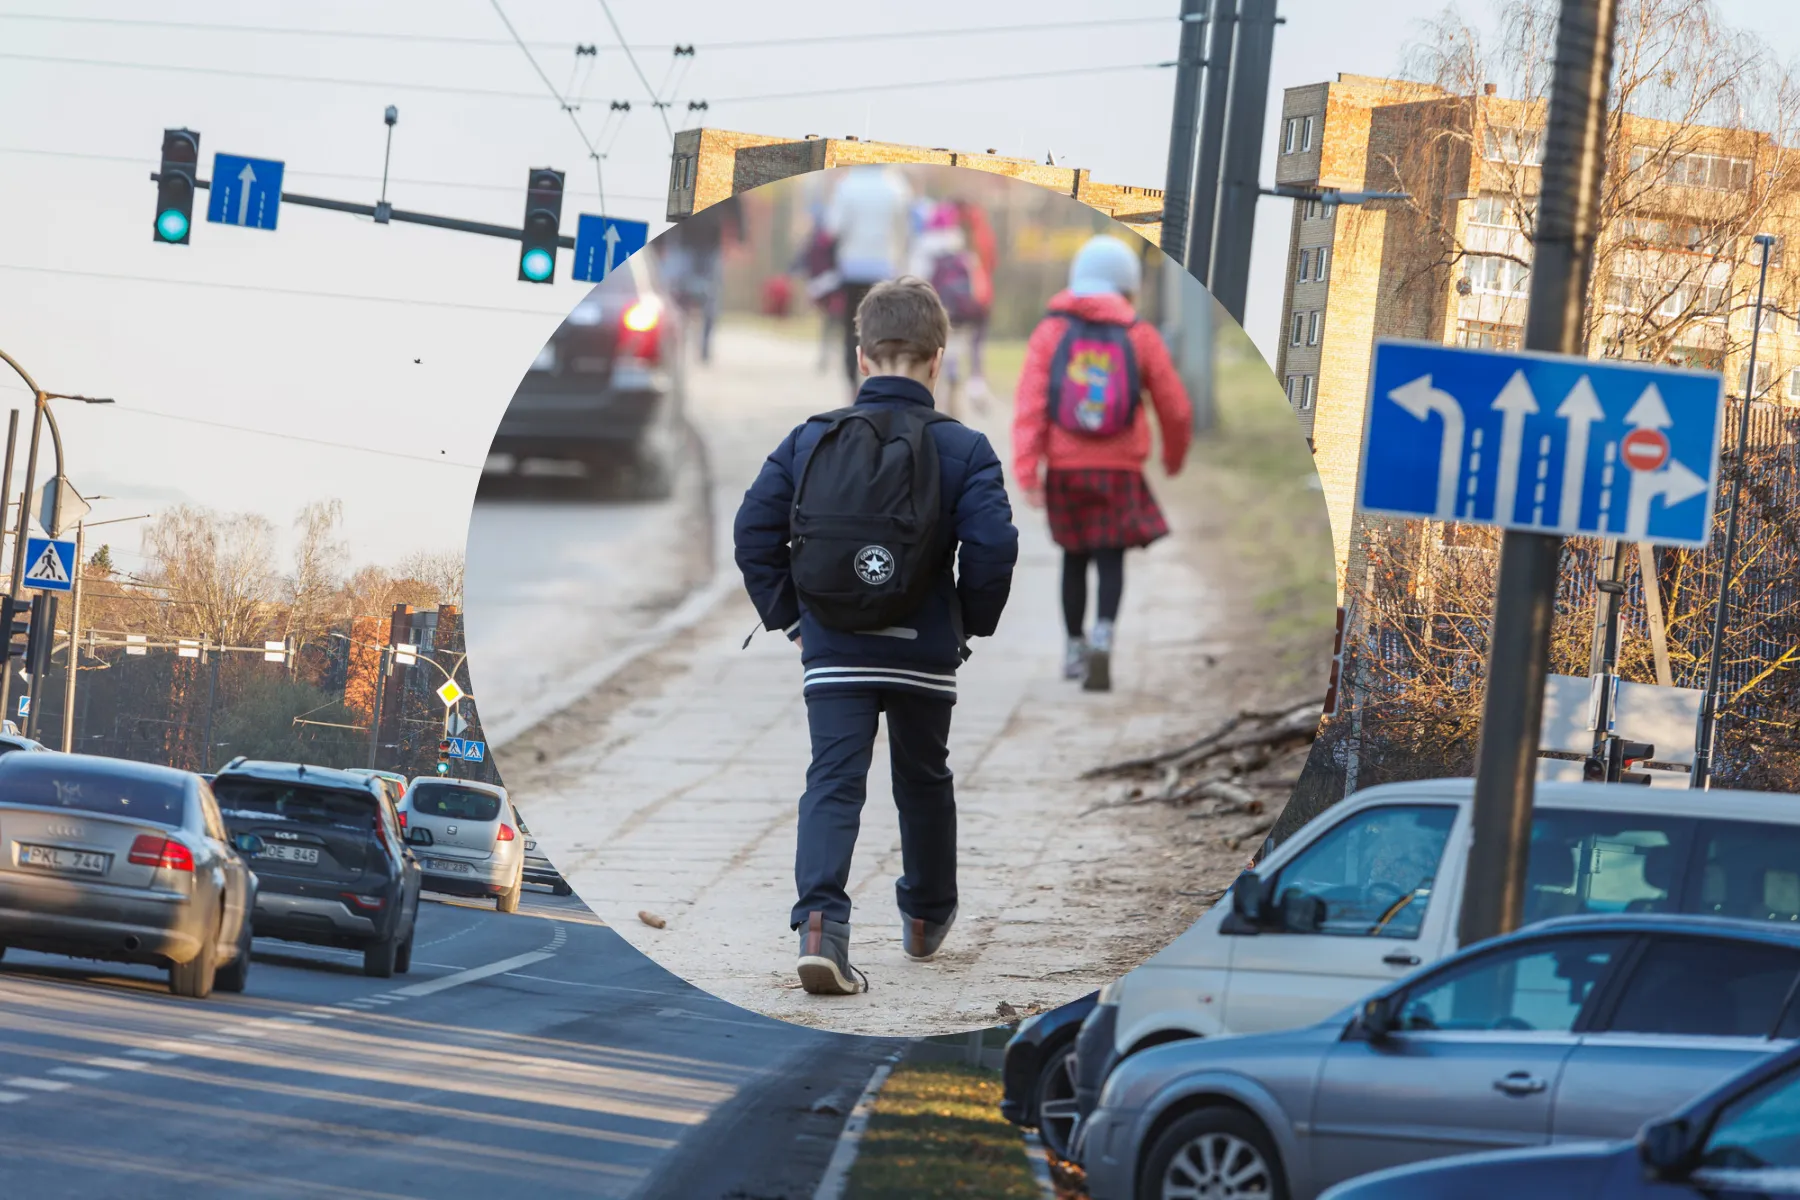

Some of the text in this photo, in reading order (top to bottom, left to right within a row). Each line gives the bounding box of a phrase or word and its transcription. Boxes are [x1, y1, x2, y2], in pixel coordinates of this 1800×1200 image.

[860, 549, 890, 562] CONVERSE
[871, 573, 887, 581] STAR
[32, 847, 101, 869] PKL 744
[293, 849, 316, 861] 846
